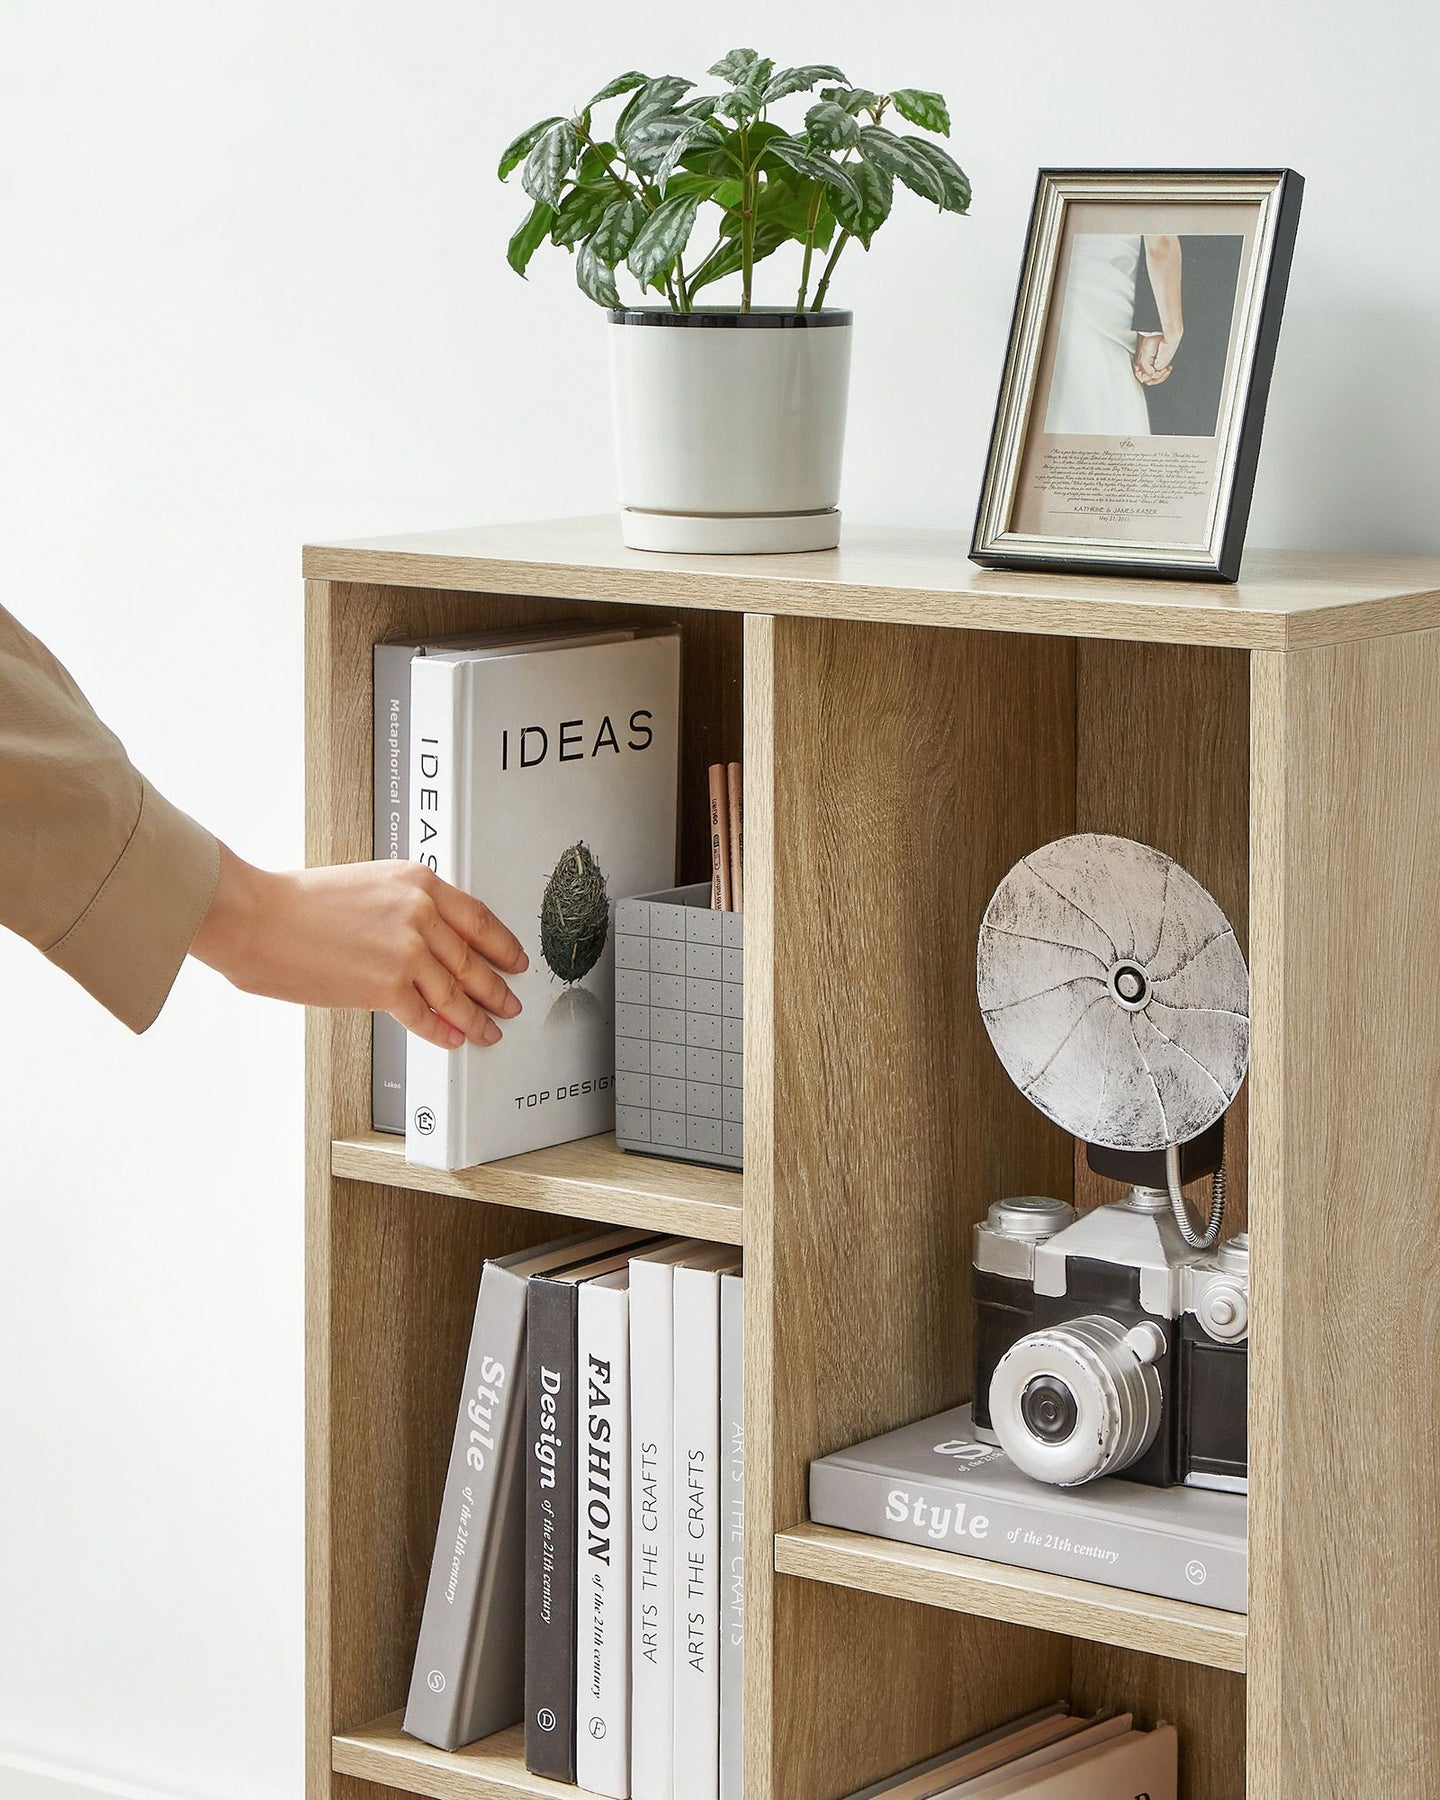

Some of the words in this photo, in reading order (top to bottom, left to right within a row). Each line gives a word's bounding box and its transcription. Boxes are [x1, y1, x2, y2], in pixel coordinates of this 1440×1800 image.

[389, 699, 400, 804] Metaphorical
[502, 710, 653, 771] IDEAS
[420, 738, 439, 875] IDEAS
[515, 1091, 550, 1110] TOP
[466, 1355, 506, 1472] Style
[534, 1365, 562, 1489] Design
[587, 1352, 611, 1567] FASHION
[461, 1486, 473, 1505] of
[541, 1499, 556, 1519] of
[642, 1443, 658, 1532] CRAFTS
[688, 1449, 705, 1539] CRAFTS
[459, 1504, 472, 1527] the
[542, 1517, 556, 1541] the
[885, 1490, 990, 1540] Style
[1006, 1528, 1022, 1545] of
[1023, 1529, 1043, 1546] the
[1043, 1534, 1073, 1554] 21th
[1073, 1544, 1120, 1564] century
[454, 1525, 469, 1559] 21th
[542, 1539, 555, 1575] 21th
[642, 1543, 658, 1591] THE
[445, 1556, 463, 1605] century
[540, 1573, 555, 1625] century
[592, 1573, 605, 1592] of
[688, 1551, 705, 1599] THE
[594, 1592, 604, 1614] the
[593, 1616, 604, 1646] 21th
[642, 1603, 658, 1664] ARTS
[688, 1612, 705, 1673] ARTS
[591, 1648, 602, 1699] century
